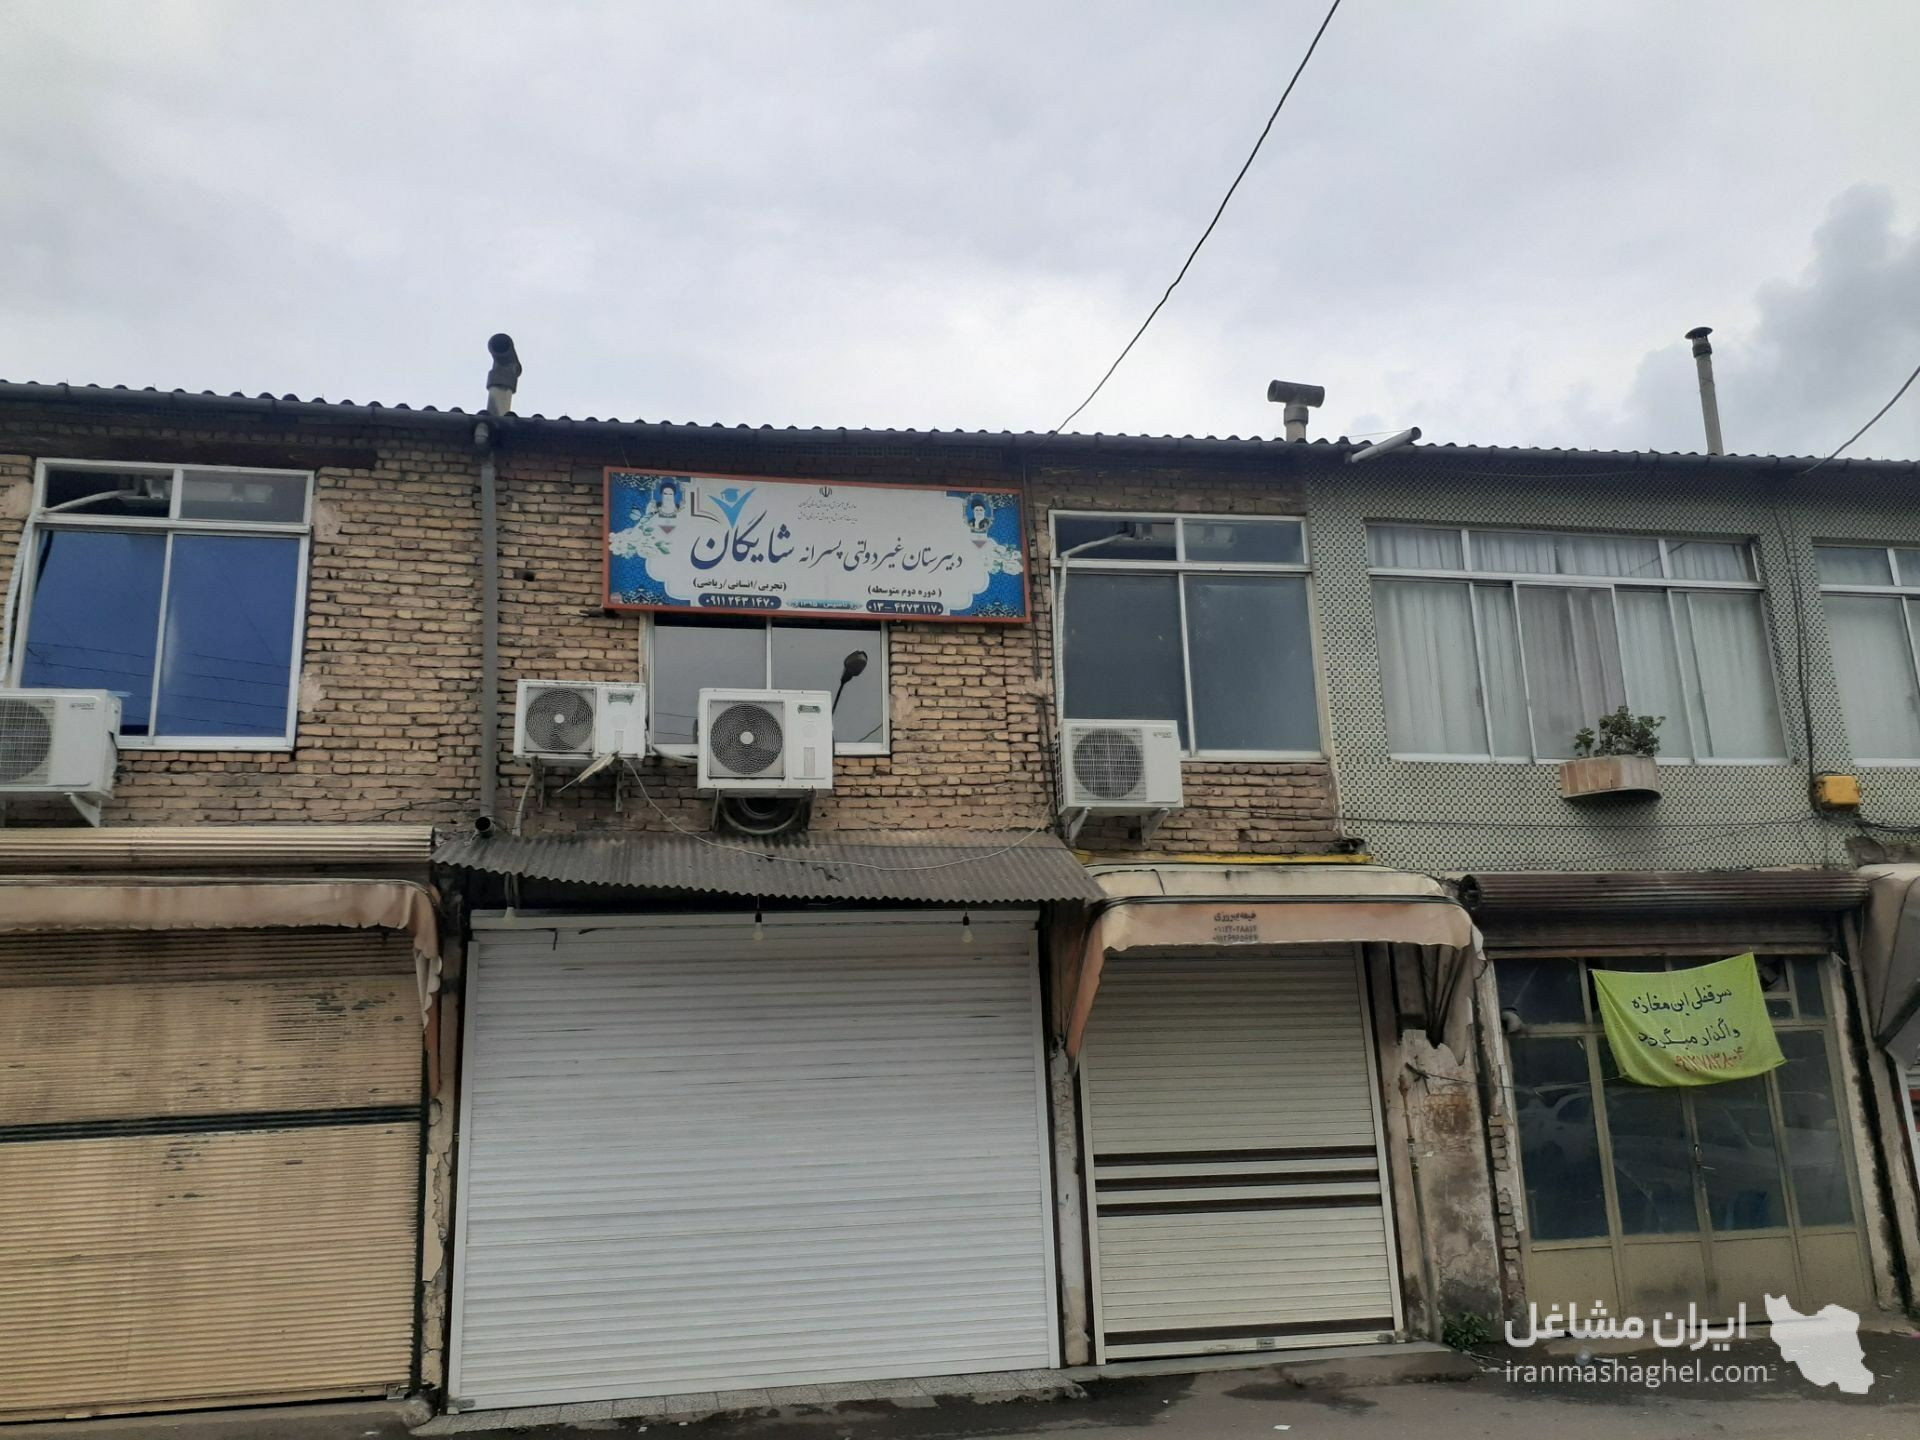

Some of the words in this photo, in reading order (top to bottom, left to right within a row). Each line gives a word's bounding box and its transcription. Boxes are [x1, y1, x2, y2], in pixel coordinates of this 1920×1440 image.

[690, 509, 795, 570] شایگان
[799, 540, 843, 568] پسرانه
[902, 547, 963, 574] دبیرستان
[1632, 991, 1670, 1013] مغازه
[1671, 991, 1690, 1016] این
